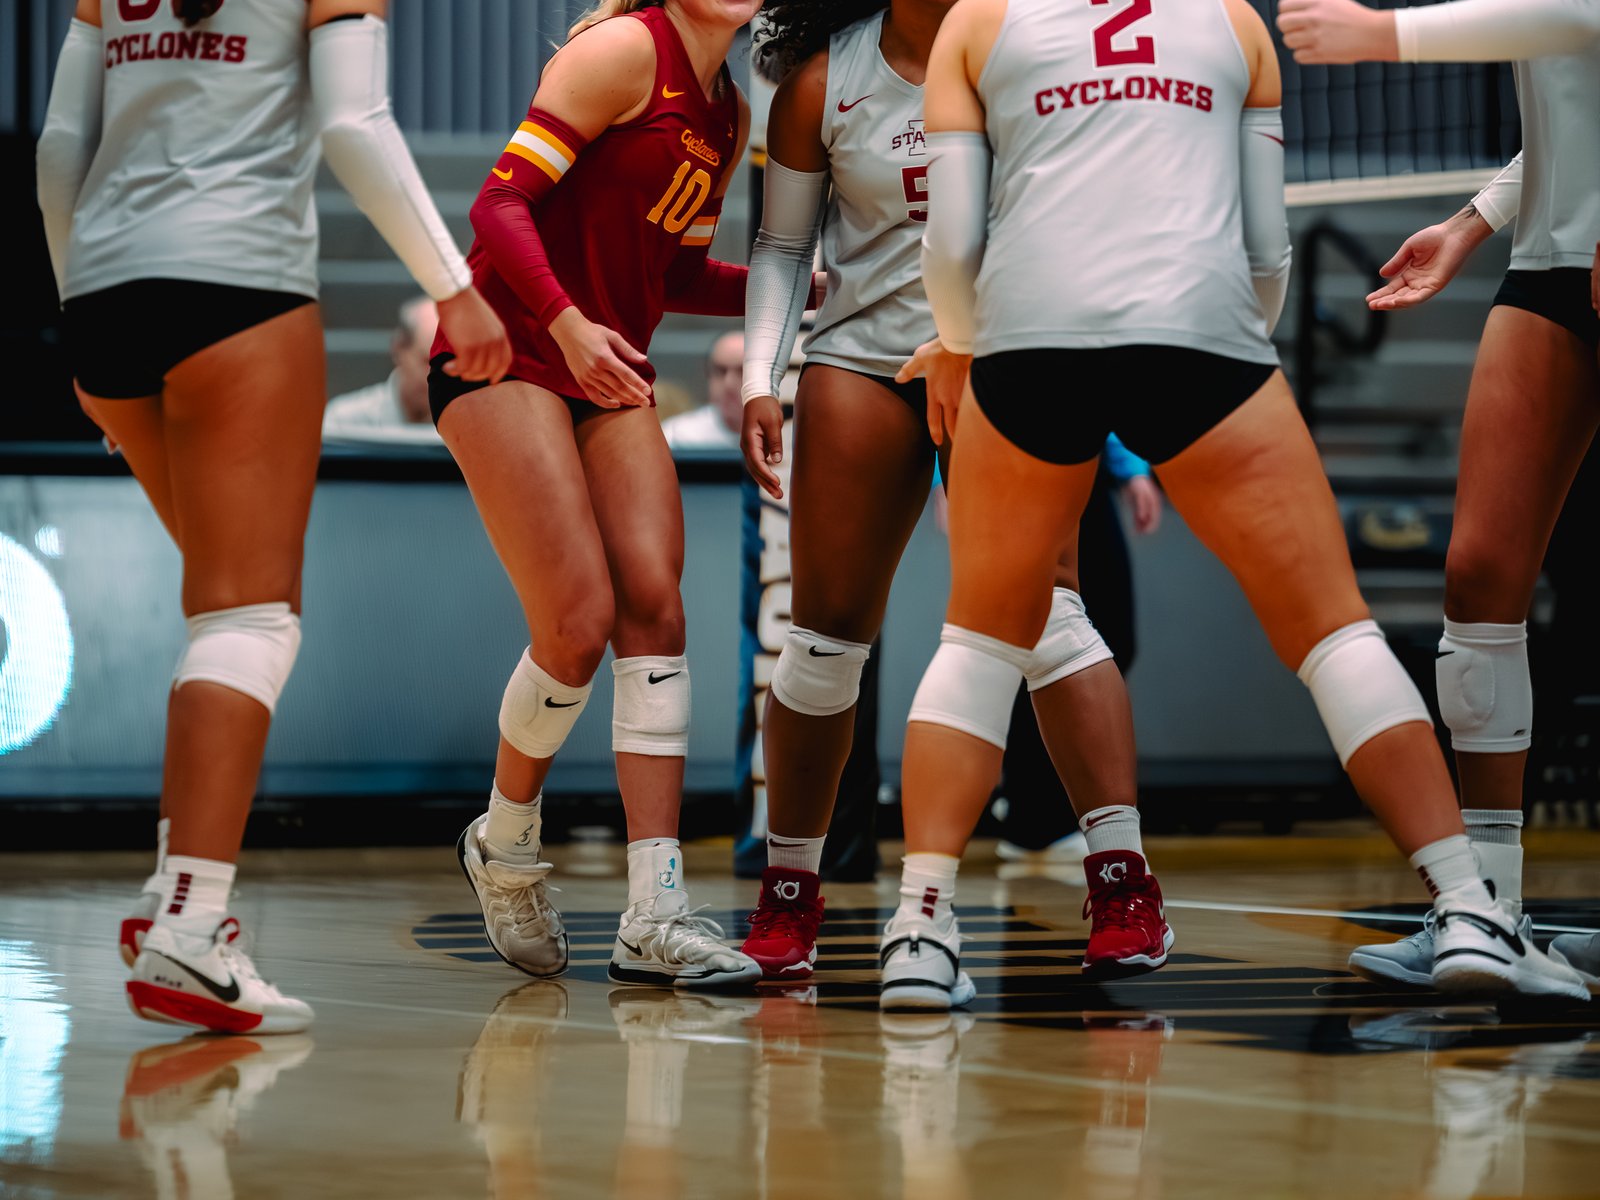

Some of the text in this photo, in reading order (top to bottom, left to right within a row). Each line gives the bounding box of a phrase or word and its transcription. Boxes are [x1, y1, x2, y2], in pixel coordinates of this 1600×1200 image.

[105, 31, 247, 69] CYCLONES
[1035, 76, 1213, 116] CYCLONES
[681, 129, 721, 167] Cyclones
[646, 160, 711, 233] 10
[901, 166, 928, 222] 5
